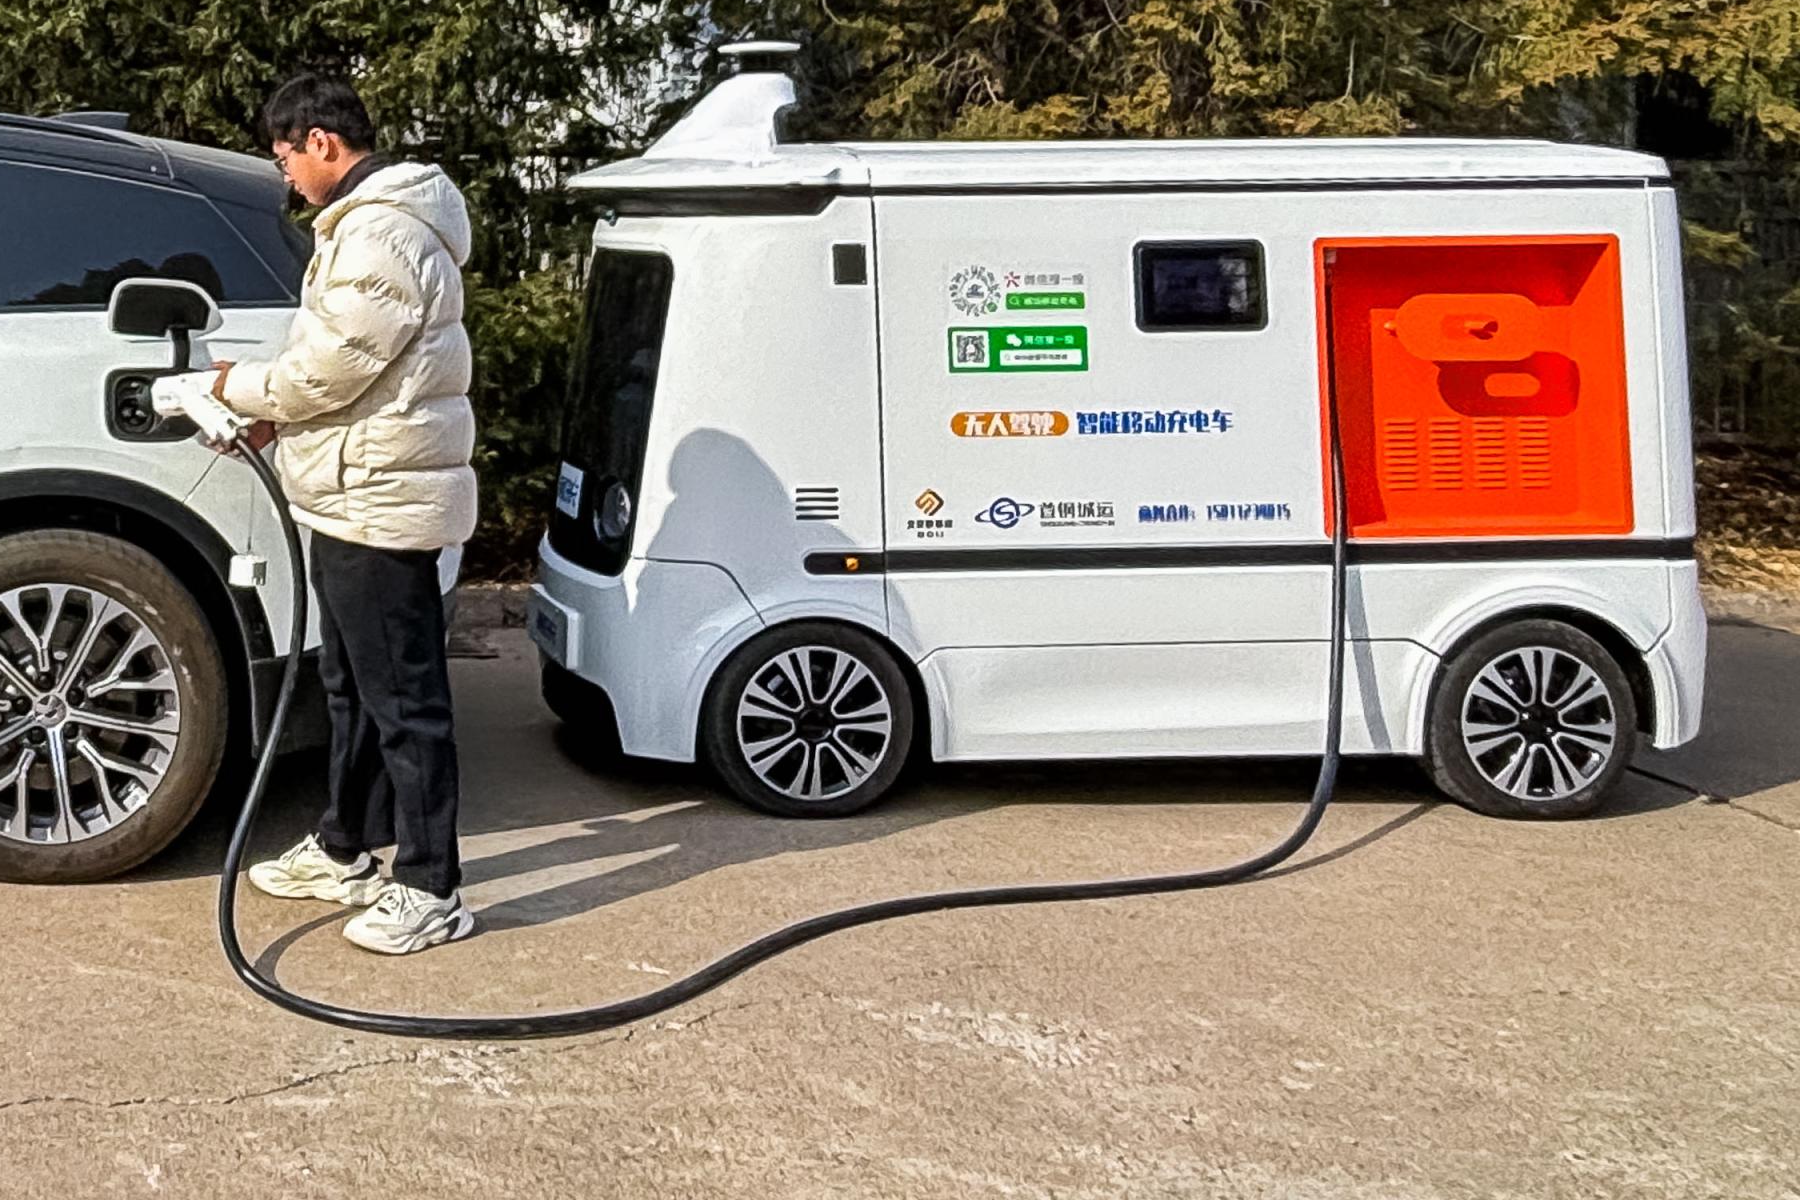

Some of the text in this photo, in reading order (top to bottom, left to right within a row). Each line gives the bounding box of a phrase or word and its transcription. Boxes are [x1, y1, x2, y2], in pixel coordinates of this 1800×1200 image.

[963, 409, 1233, 436] 无人驾驶 智能移动充电车
